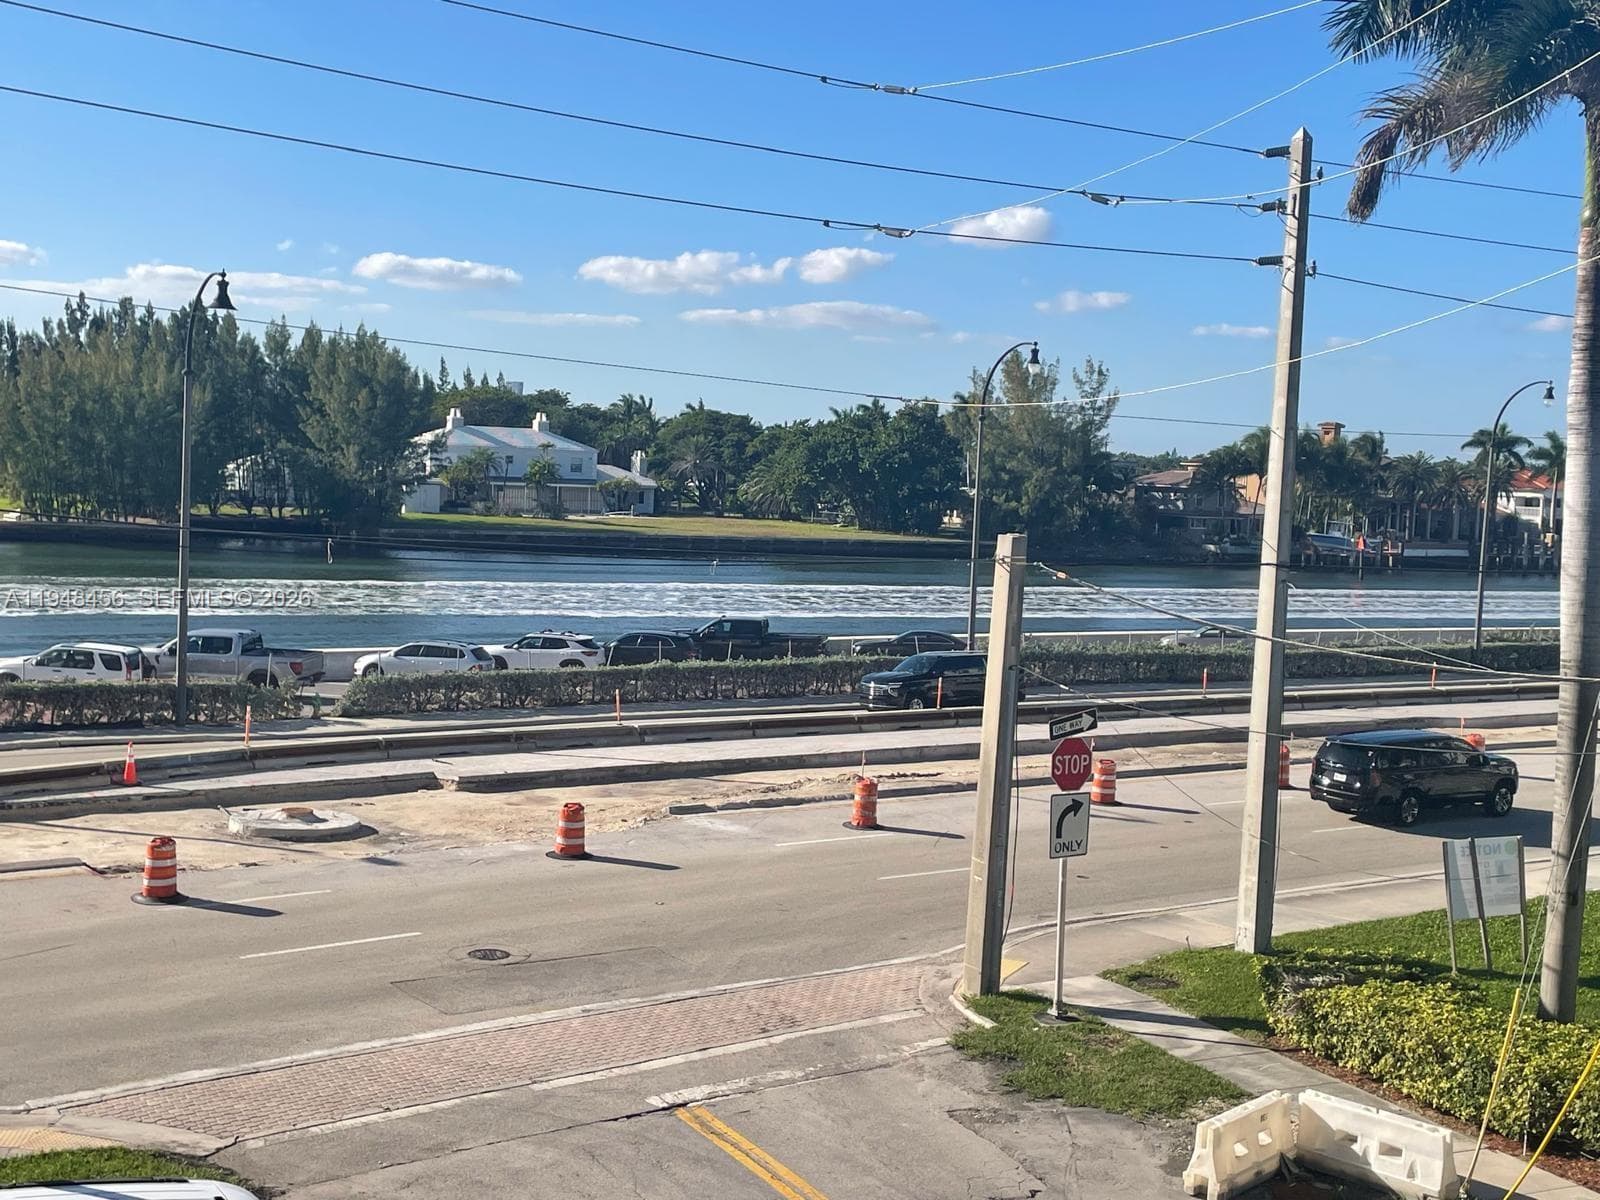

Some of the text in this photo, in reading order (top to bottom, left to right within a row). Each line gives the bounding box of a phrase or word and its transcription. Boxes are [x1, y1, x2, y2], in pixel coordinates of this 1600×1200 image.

[1055, 719, 1083, 734] ONE WAY
[1054, 755, 1089, 775] STOP
[1054, 839, 1083, 853] ONLY
